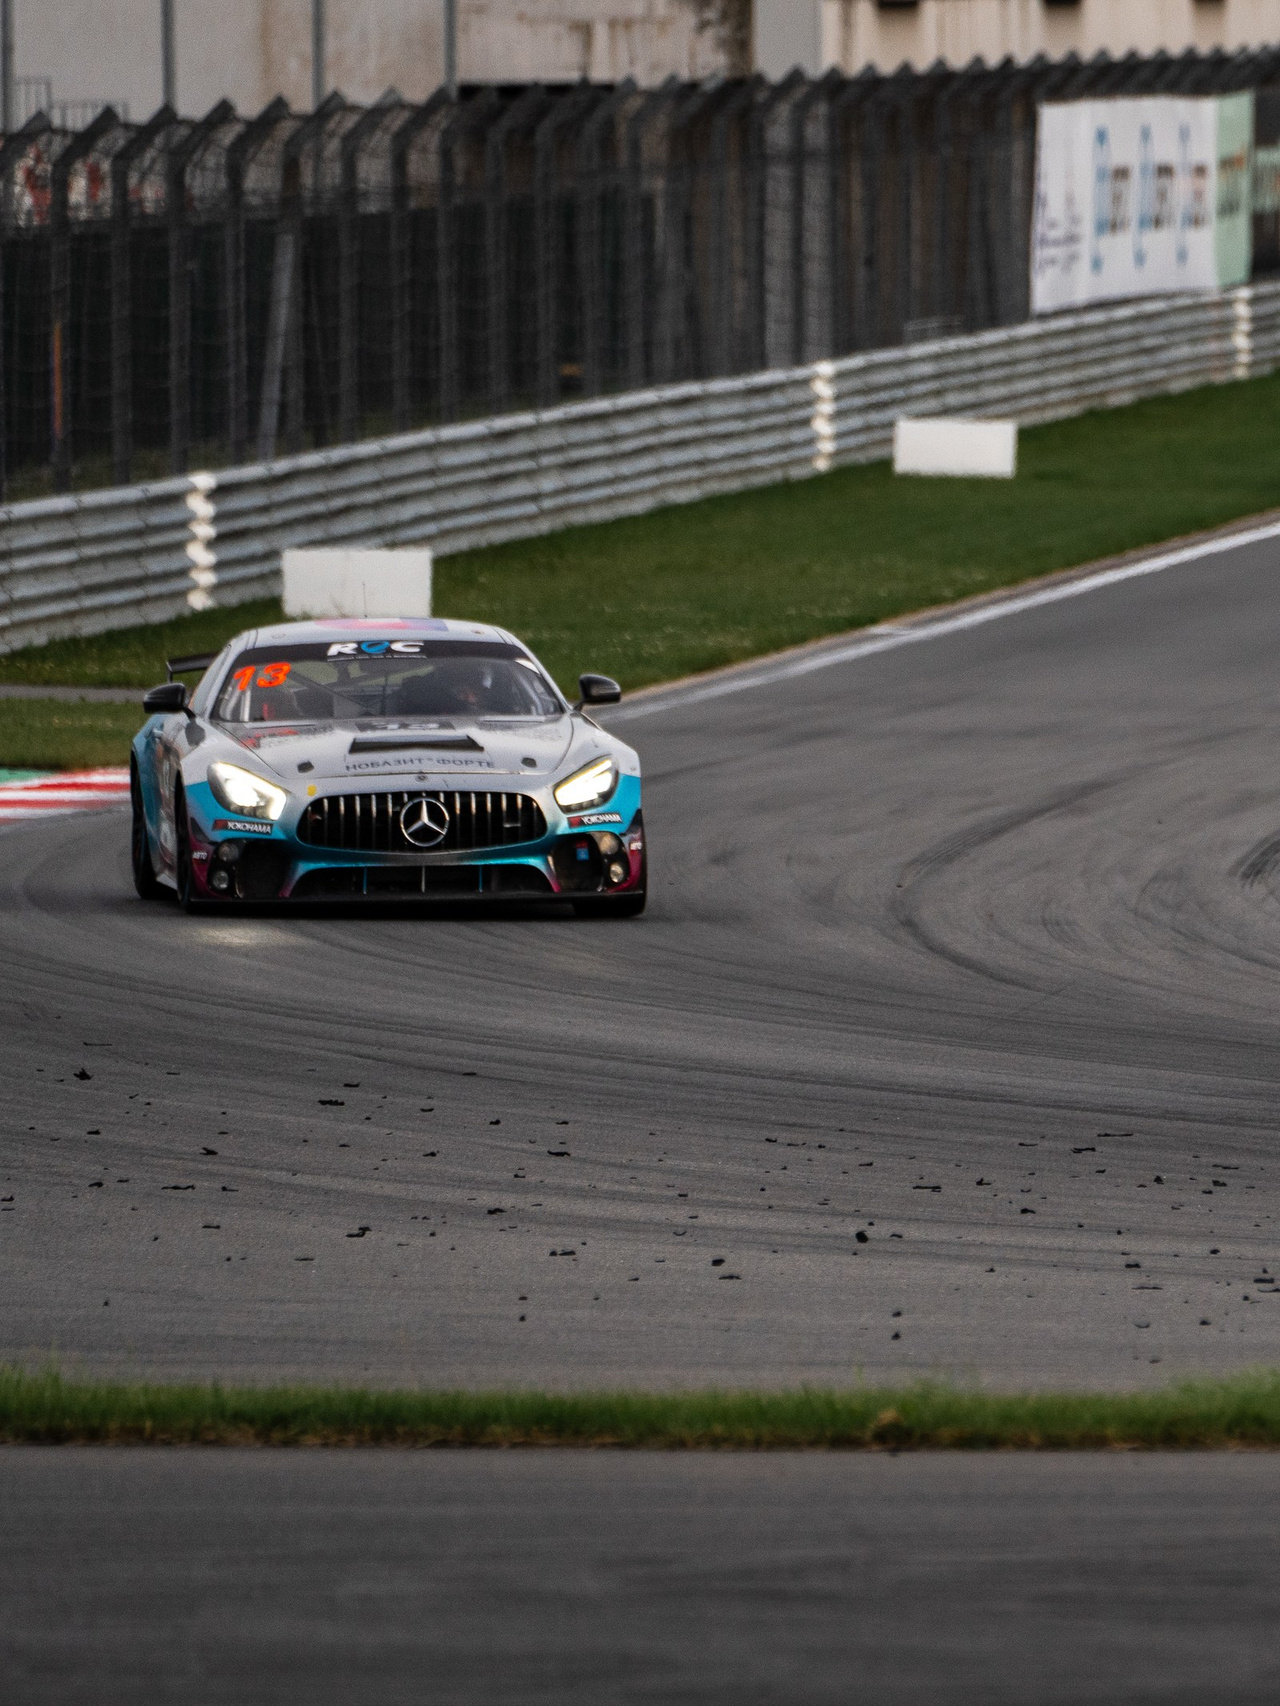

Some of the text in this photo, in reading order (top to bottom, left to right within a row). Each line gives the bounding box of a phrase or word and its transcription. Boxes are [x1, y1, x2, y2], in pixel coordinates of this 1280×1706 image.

[234, 661, 292, 691] 13
[581, 813, 622, 825] YOKOHAMA
[227, 820, 271, 834] YOKOHAMA
